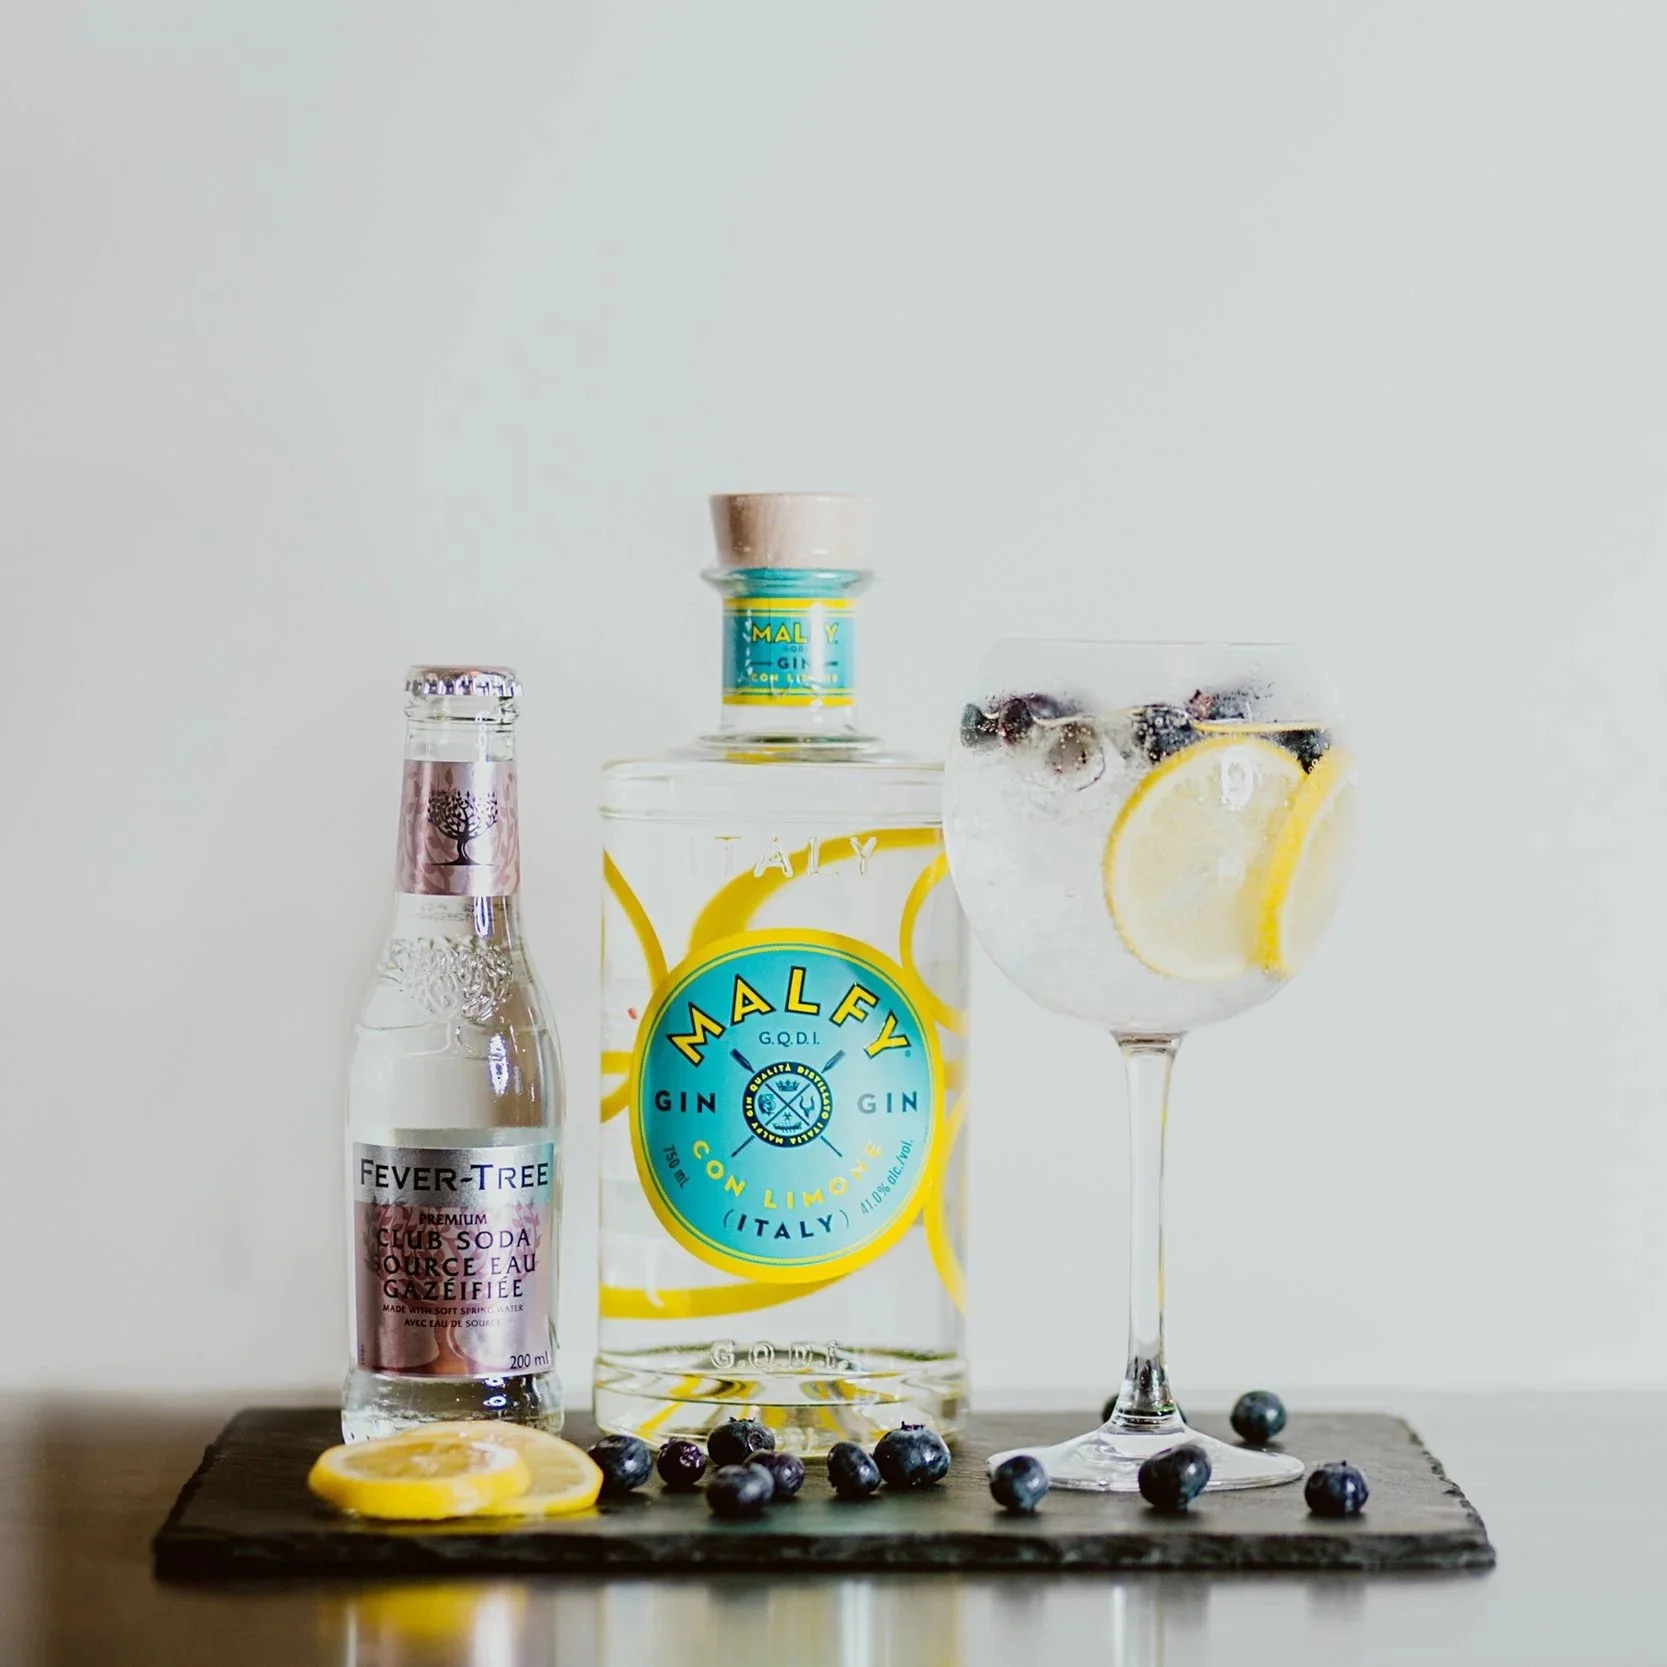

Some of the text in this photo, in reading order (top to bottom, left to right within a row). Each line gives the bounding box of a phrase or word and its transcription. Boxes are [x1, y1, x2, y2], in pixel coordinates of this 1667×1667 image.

[751, 622, 839, 644] MALY
[666, 966, 911, 1068] MALFY
[759, 1031, 820, 1046] G.Q.D.I.
[655, 1090, 716, 1114] GIN
[797, 1066, 830, 1119] DISTILLATO
[857, 1091, 917, 1114] GIN
[746, 1096, 754, 1118] GIN
[751, 1122, 784, 1145] MALFY
[789, 1122, 824, 1145] ITALIA
[663, 1144, 680, 1169] 750
[361, 1158, 549, 1191] FEVER-TREE
[693, 1140, 883, 1209] CON LIMONE
[860, 1182, 891, 1214] 41.0%
[419, 1213, 488, 1226] PREMIUM
[377, 1228, 531, 1250] CLUB SODA
[491, 1253, 536, 1275] EAU
[384, 1276, 523, 1301] GAZÉIFIÉE
[383, 1304, 406, 1314] MADE
[409, 1305, 432, 1315] WITH
[434, 1306, 457, 1315] SOFT
[460, 1306, 494, 1315] SPRING
[404, 1320, 427, 1328] AVEC
[430, 1320, 448, 1328] EAU
[451, 1320, 462, 1328] DE
[510, 1351, 549, 1370] 200 ml
